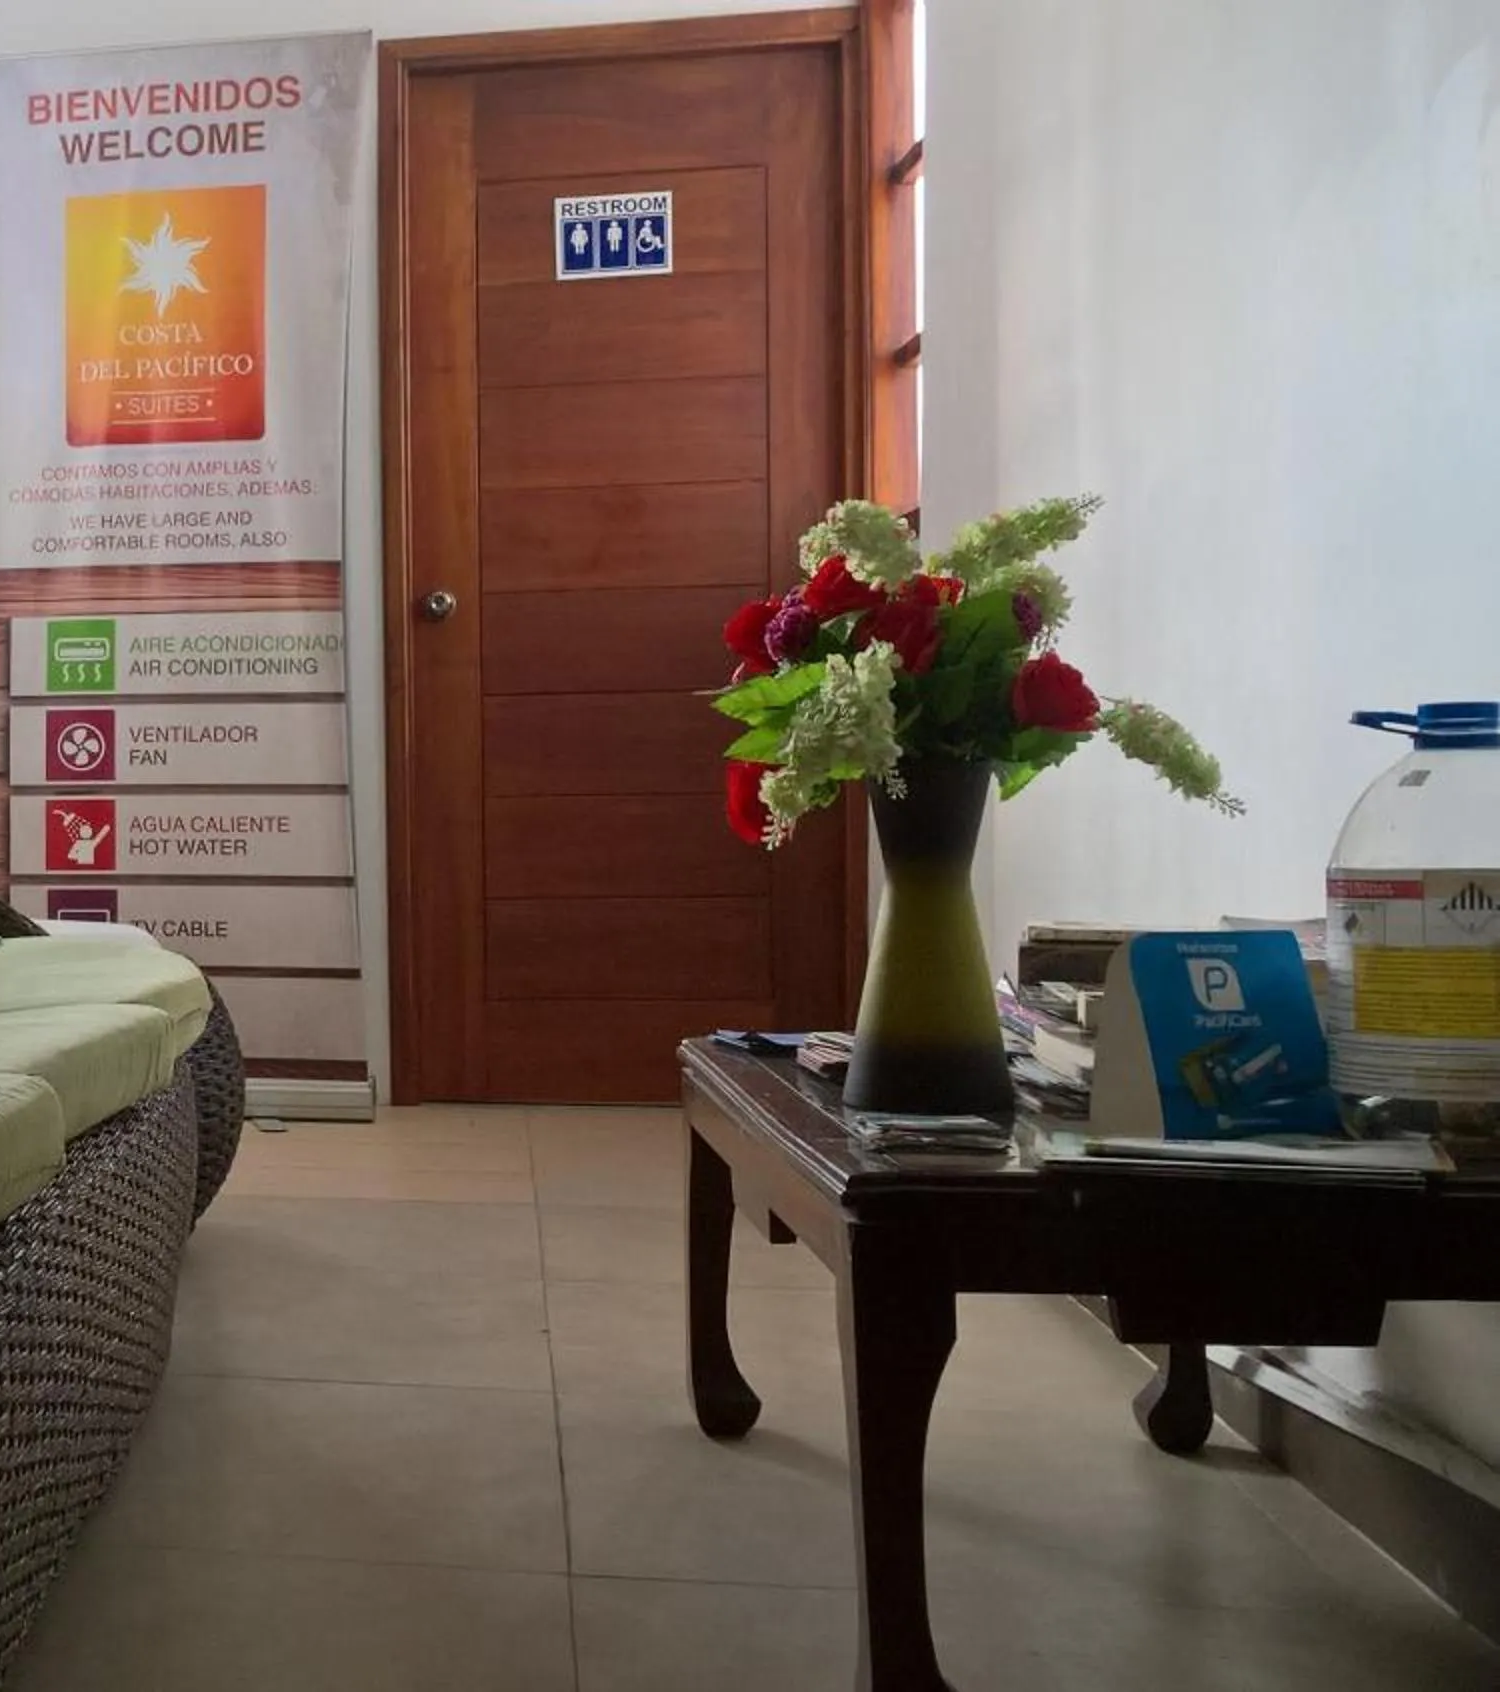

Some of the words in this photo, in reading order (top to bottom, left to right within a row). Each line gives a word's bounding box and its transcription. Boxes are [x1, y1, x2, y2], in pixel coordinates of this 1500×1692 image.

[28, 75, 301, 125] BIENVENIDOS
[60, 121, 265, 165] WELCOME
[561, 196, 667, 217] RESTROOM
[119, 323, 203, 346] COSTA
[80, 361, 131, 383] DEL
[136, 351, 253, 379] PACÍFICO
[41, 463, 138, 482] CONTAMOS
[142, 462, 181, 477] CON
[185, 459, 261, 477] AMPLIAS
[70, 514, 96, 529] WE
[100, 512, 147, 529] HAVE
[152, 510, 211, 528] LARGE
[215, 509, 252, 526] AND
[31, 534, 160, 553] COMFORTABLE
[129, 636, 176, 653] AIRE
[129, 659, 161, 676] AIR
[168, 657, 319, 676] CONDITIONING
[129, 726, 258, 744] VENTILADOR
[129, 750, 167, 766] FAN
[129, 816, 185, 834] AGUA
[190, 816, 291, 834] CALIENTE
[129, 839, 170, 856] HOT
[176, 839, 247, 856] WATER
[162, 920, 228, 938] CABLE
